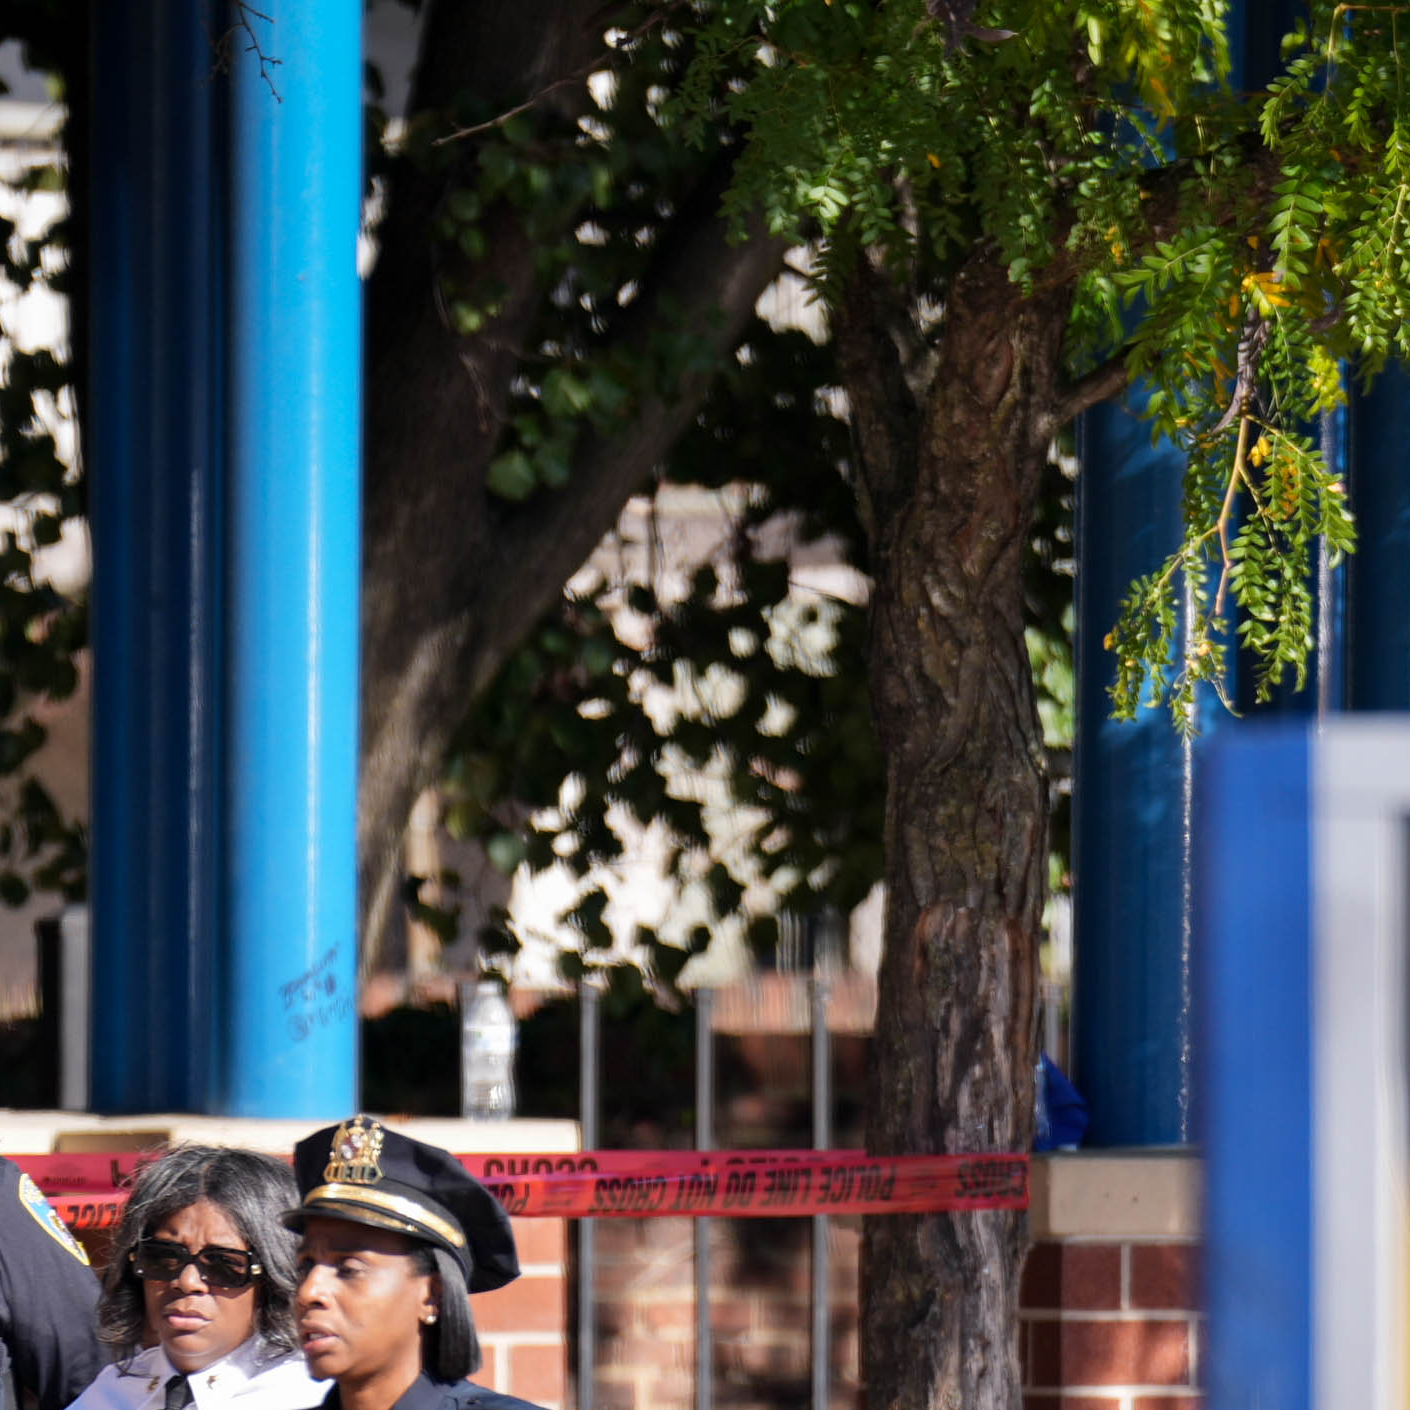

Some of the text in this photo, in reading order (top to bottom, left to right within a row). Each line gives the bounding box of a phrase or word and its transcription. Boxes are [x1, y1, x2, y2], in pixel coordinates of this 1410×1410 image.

[587, 1163, 897, 1213] POLICE LINE DO NOT CROSS
